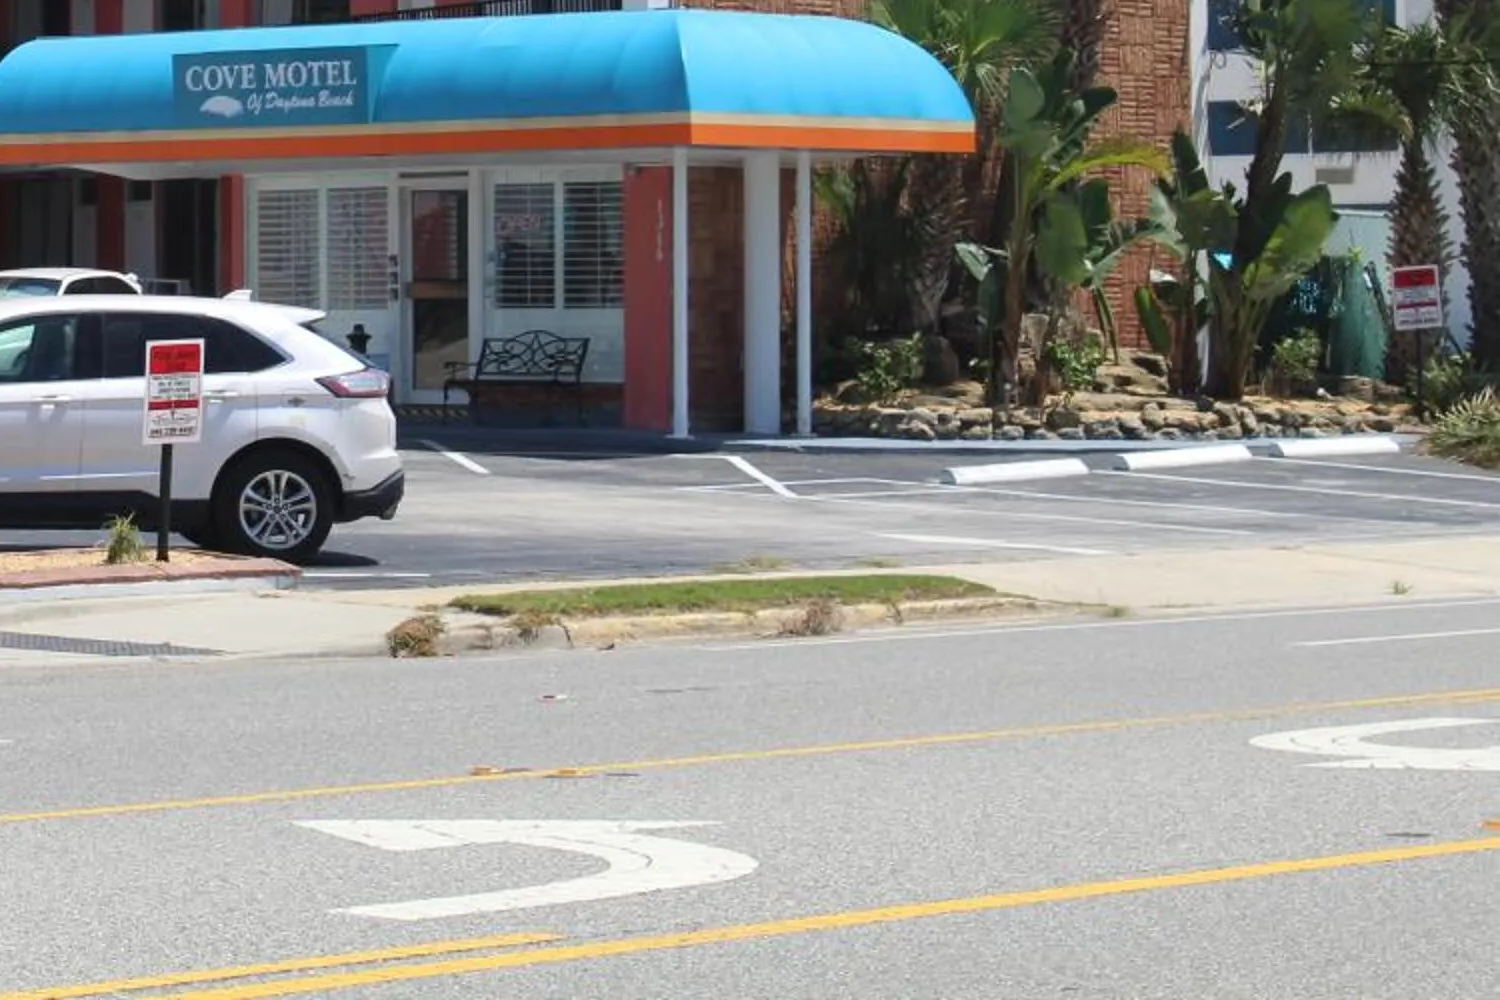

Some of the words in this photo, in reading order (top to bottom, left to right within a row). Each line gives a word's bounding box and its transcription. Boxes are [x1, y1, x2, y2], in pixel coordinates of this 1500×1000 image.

[185, 64, 256, 91] COVE
[264, 60, 357, 88] MOTEL
[247, 92, 263, 115] Of
[265, 93, 314, 112] Daytona
[317, 89, 354, 107] Beach
